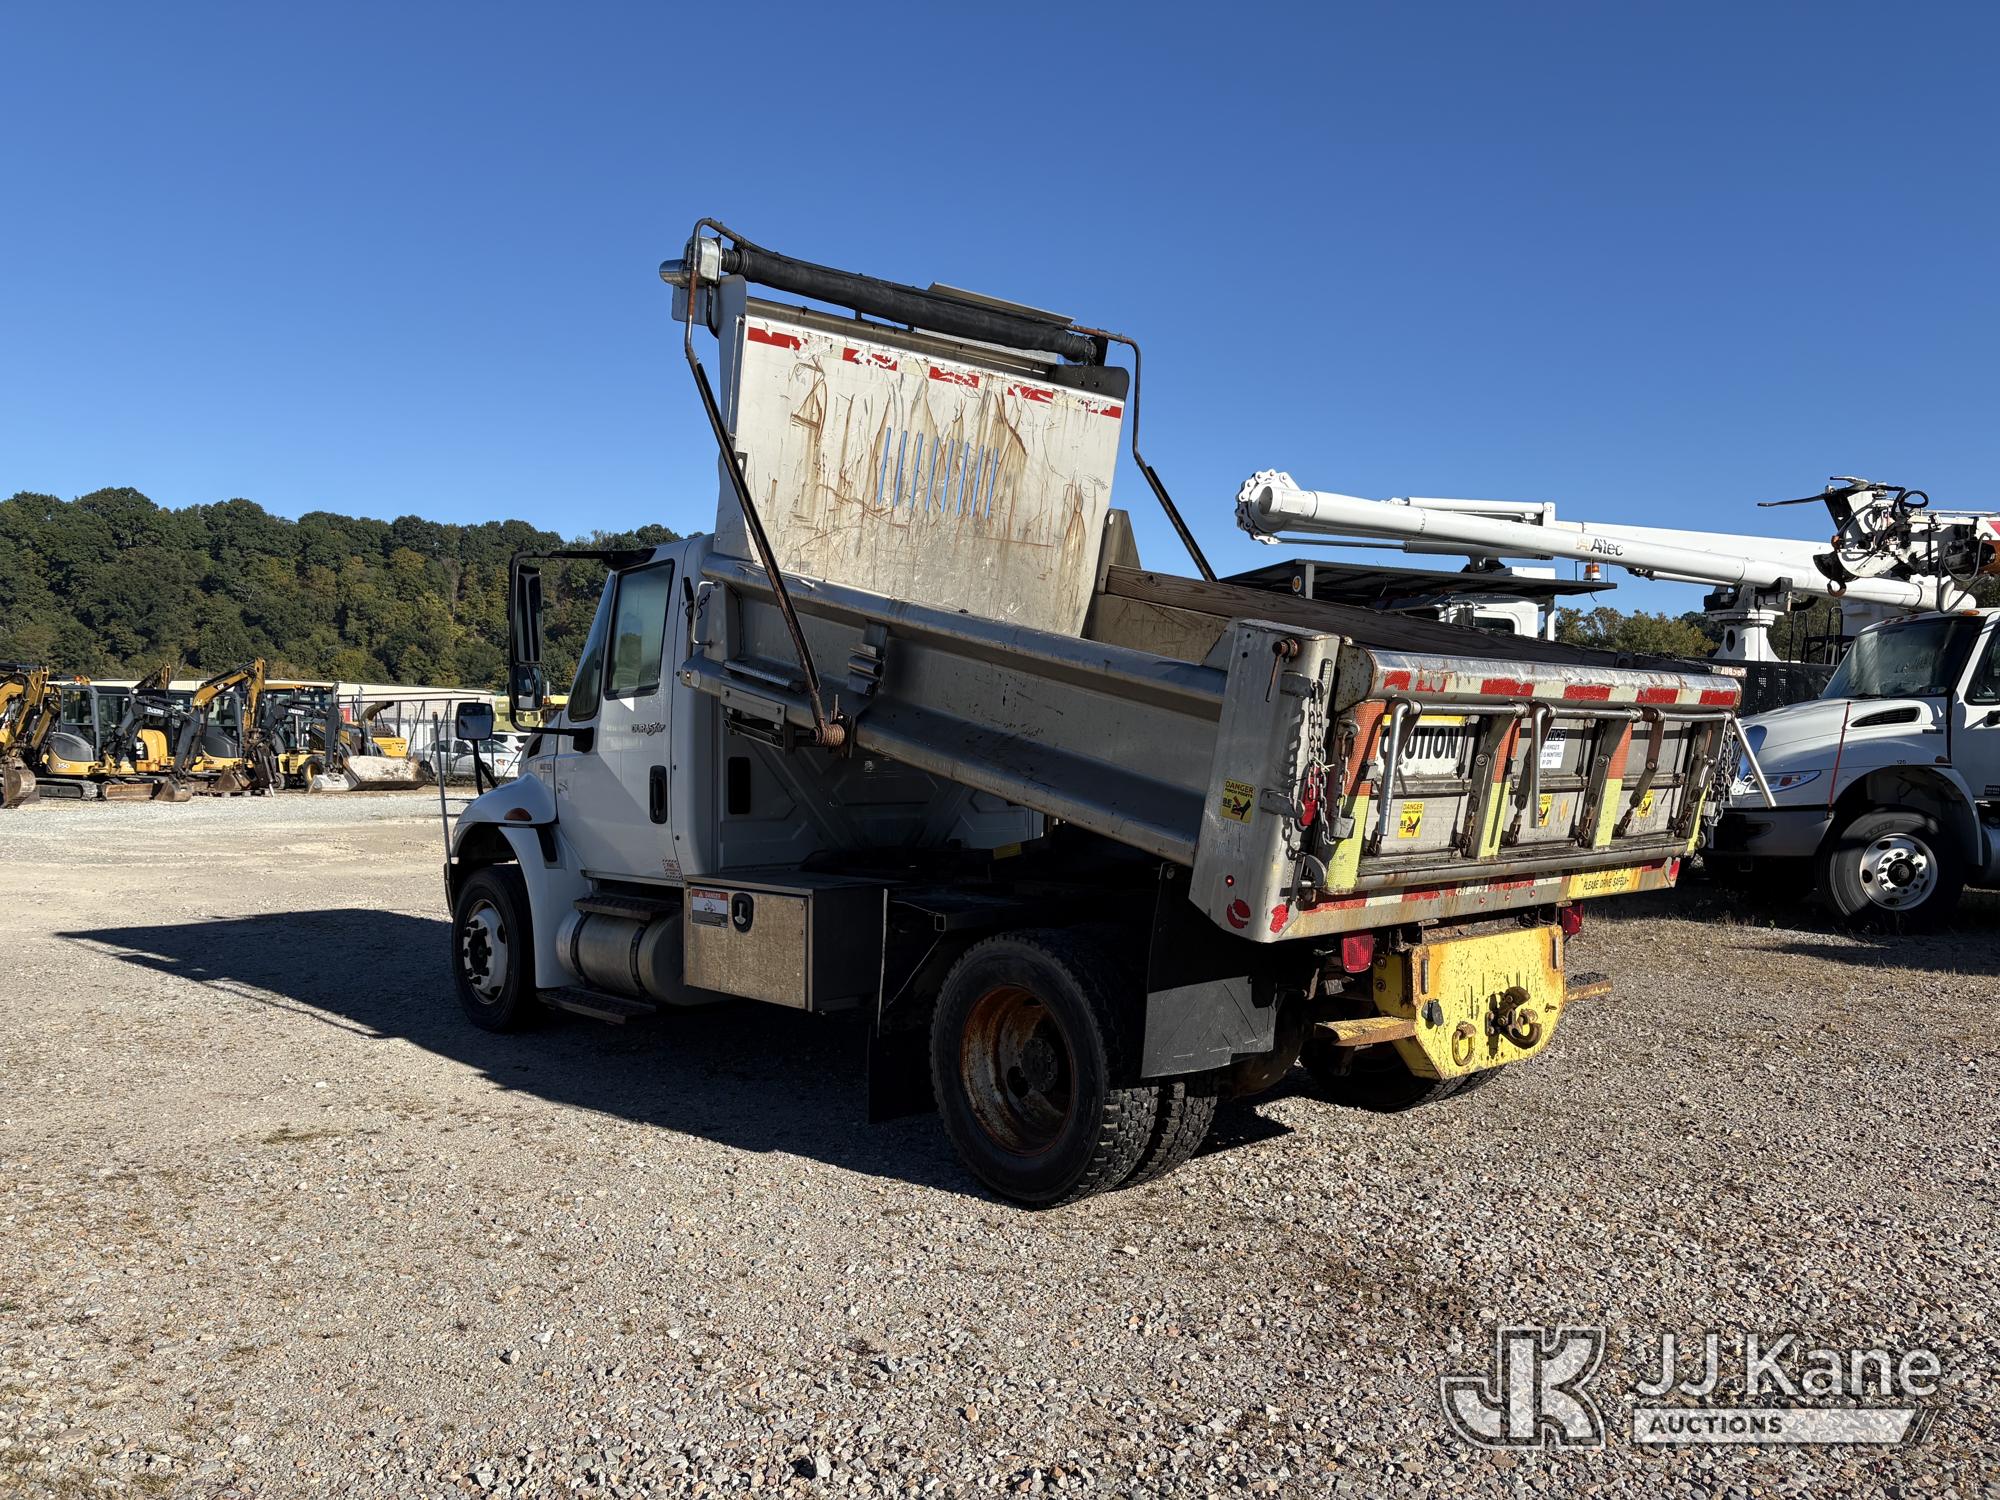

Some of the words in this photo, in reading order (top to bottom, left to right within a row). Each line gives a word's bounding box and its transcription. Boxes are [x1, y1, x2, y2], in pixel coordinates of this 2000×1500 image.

[1590, 538, 1624, 556] Altec
[1379, 727, 1460, 760] CUTION
[1225, 781, 1254, 795] DANGER
